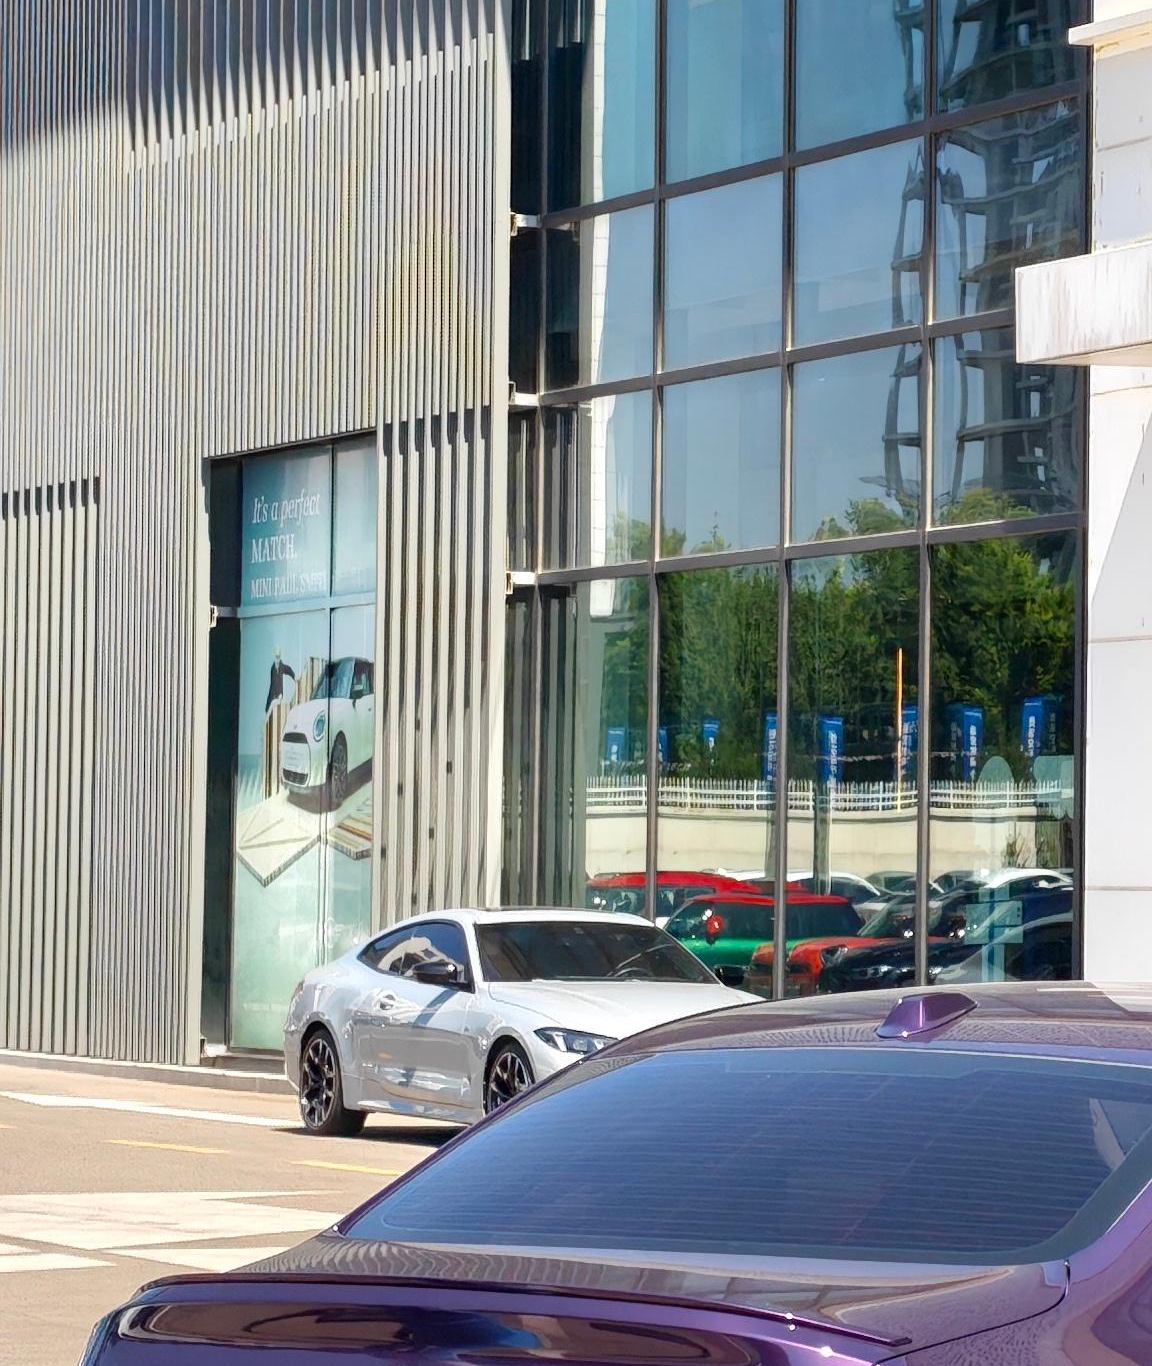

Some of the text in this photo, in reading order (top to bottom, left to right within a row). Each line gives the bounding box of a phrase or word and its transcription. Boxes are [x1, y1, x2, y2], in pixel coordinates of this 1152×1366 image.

[252, 488, 321, 528] It's a perfect
[251, 533, 298, 564] MATCH.
